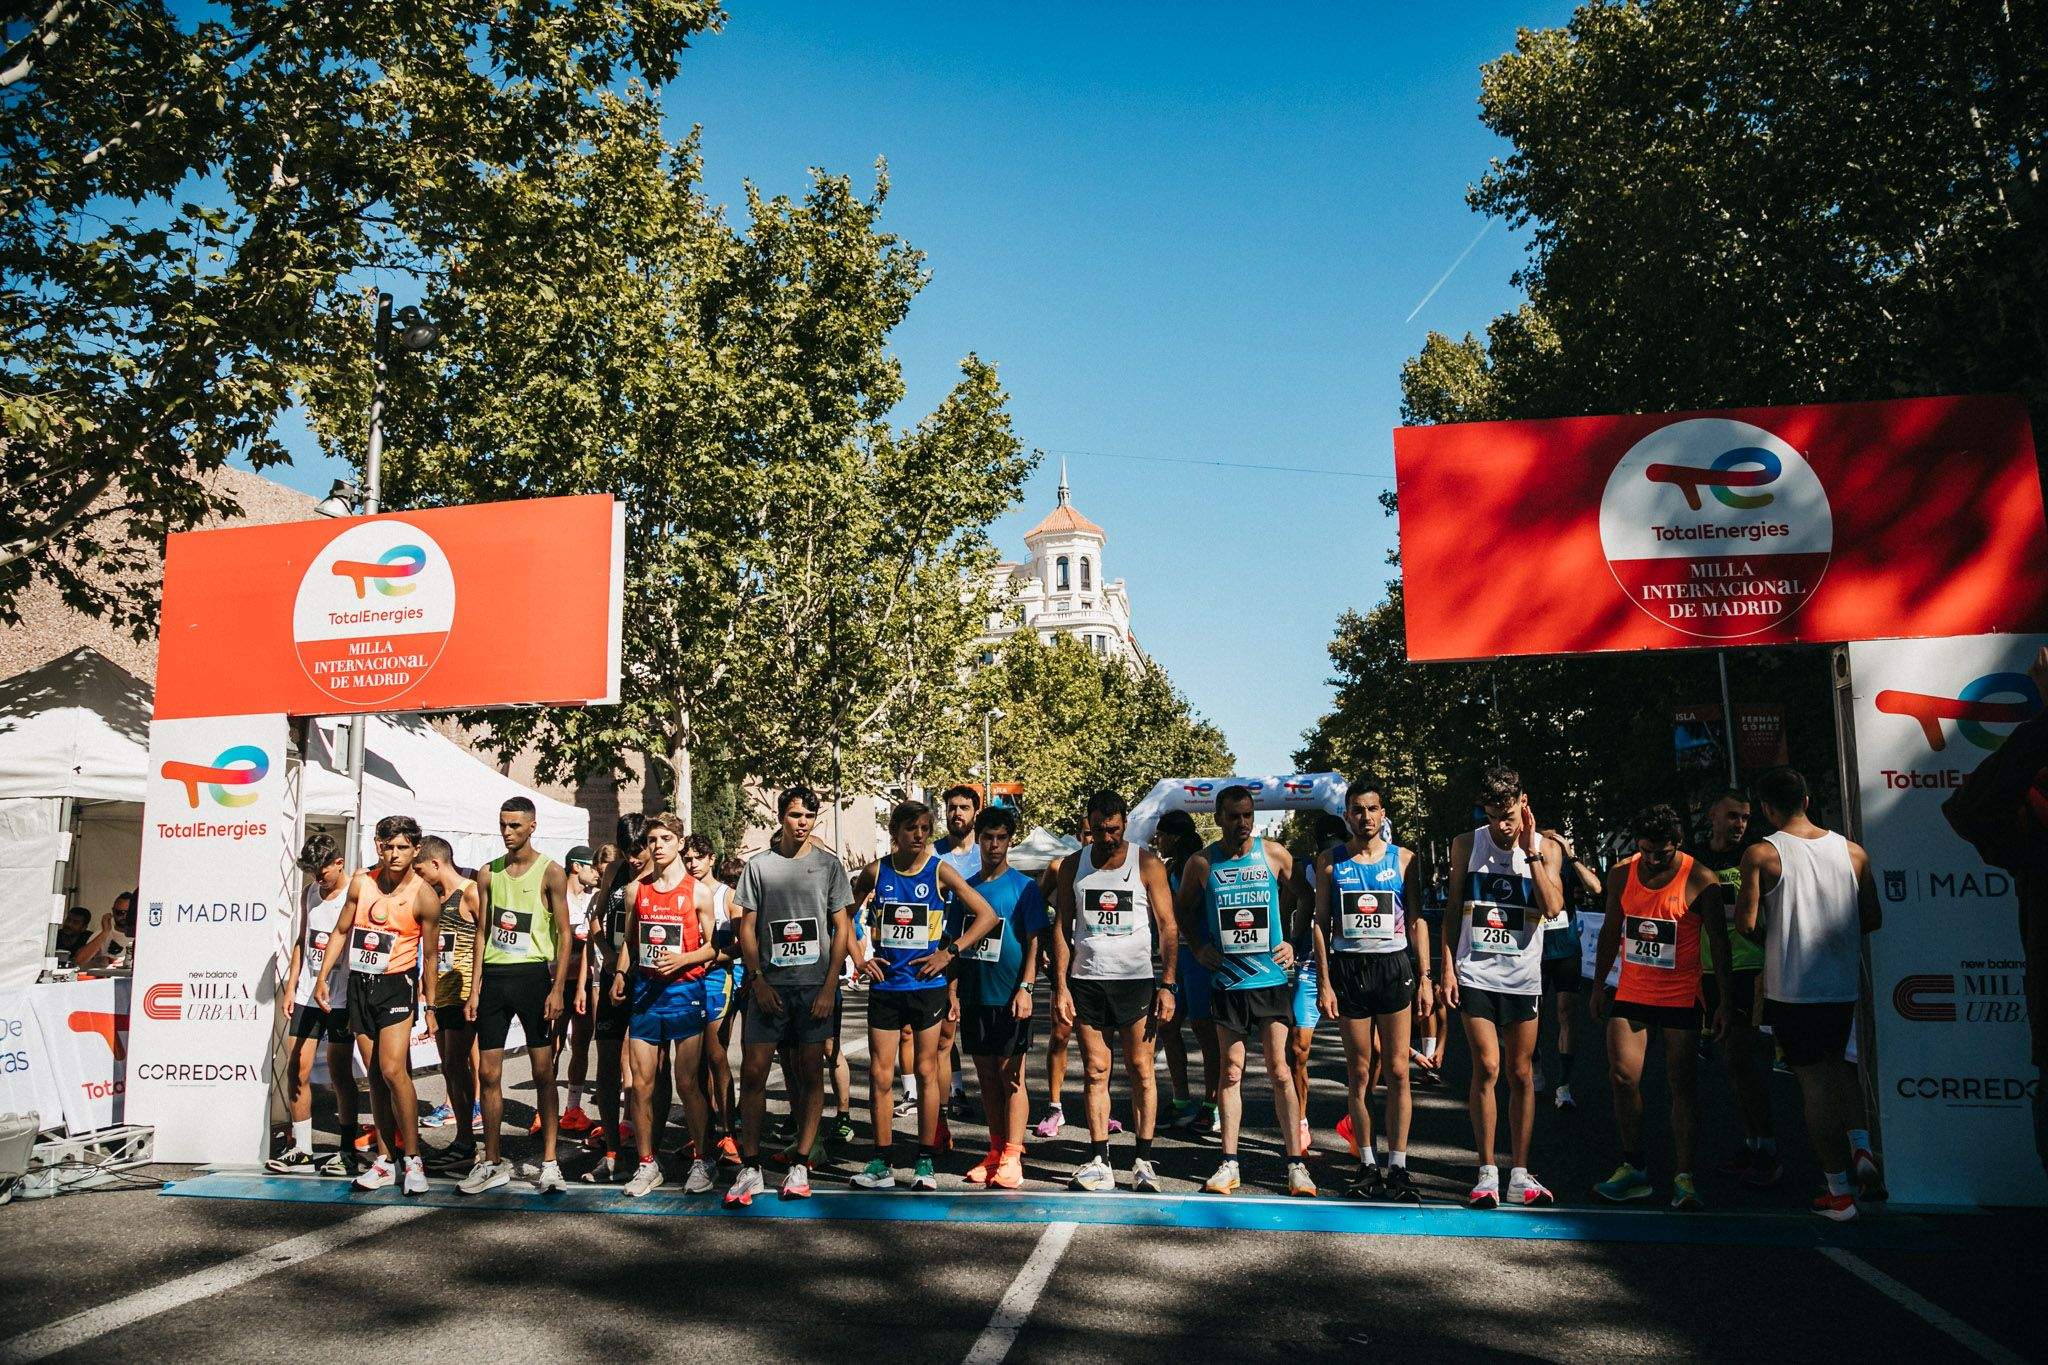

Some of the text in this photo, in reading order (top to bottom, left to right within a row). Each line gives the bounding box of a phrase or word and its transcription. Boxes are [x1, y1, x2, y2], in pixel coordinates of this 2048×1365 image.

[1652, 521, 1790, 541] TotalEnergies
[1690, 561, 1754, 578] MILLA
[328, 606, 424, 625] TotalEnergies
[1669, 600, 1782, 619] DE MADRID
[349, 640, 394, 656] MILLA
[330, 672, 410, 689] DE MADRID
[157, 820, 267, 841] TotalEnergies
[1218, 890, 1270, 906] ATLETISMO
[177, 902, 267, 923] MADRID
[1098, 911, 1119, 925] 291
[1355, 914, 1382, 929] 259
[497, 930, 517, 945] 239
[892, 925, 914, 940] 278
[1233, 929, 1258, 944] 254
[1483, 928, 1510, 944] 236
[359, 950, 378, 965] 286
[781, 942, 806, 957] 245
[1635, 941, 1660, 958] 249
[1961, 959, 1985, 969] new
[206, 970, 238, 979] balance
[190, 983, 249, 999] MILLA
[187, 1004, 258, 1020] URBANA
